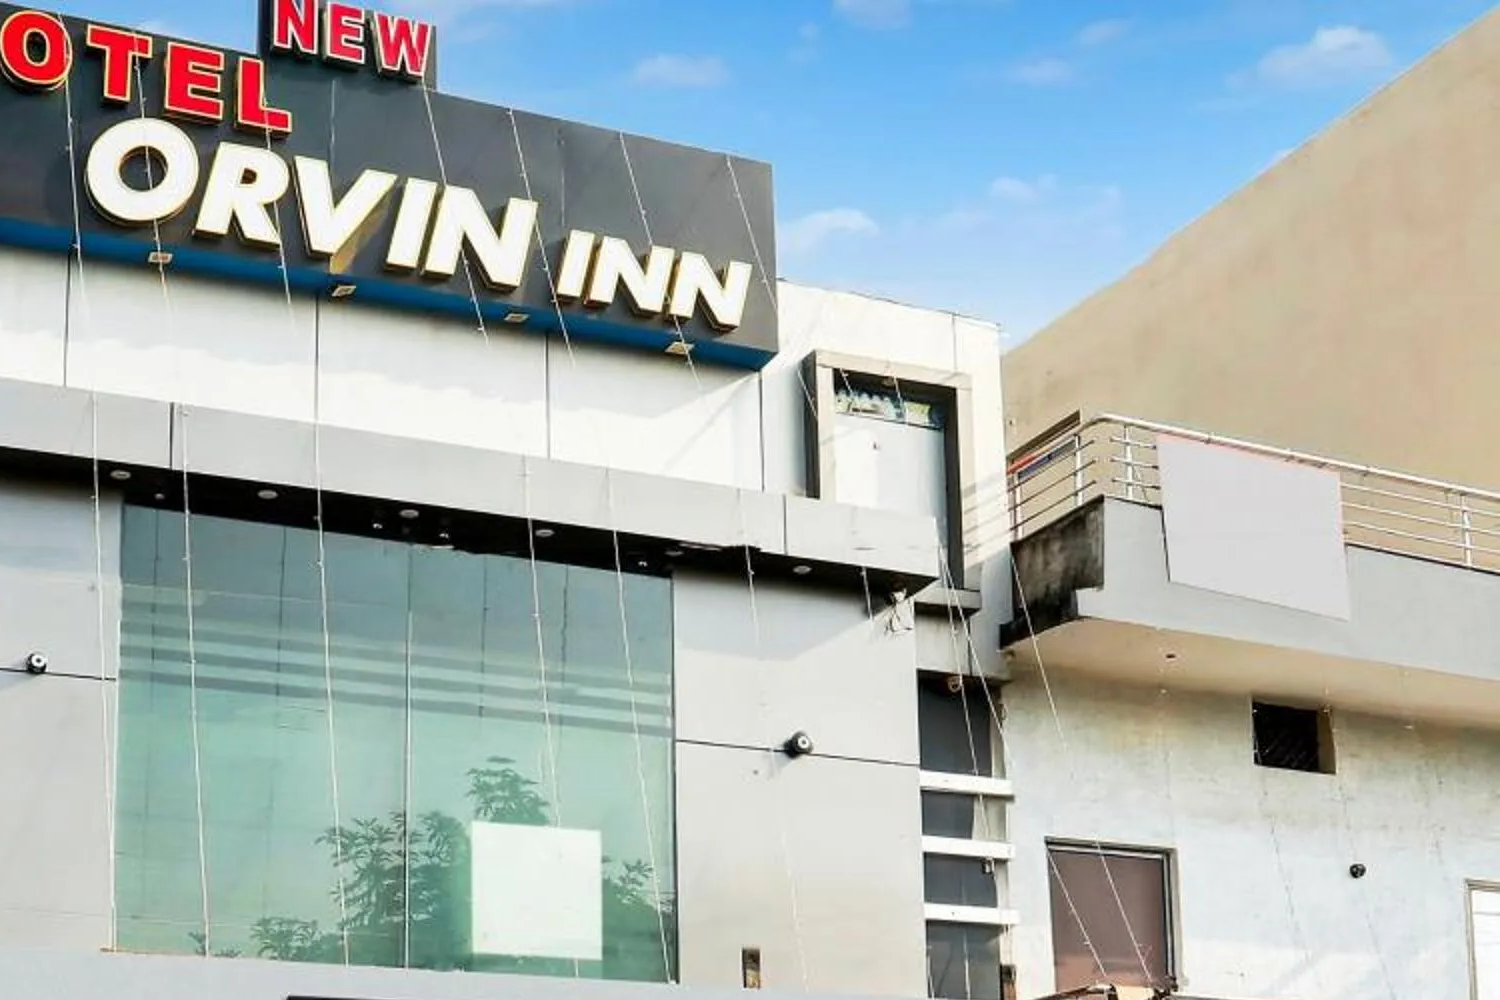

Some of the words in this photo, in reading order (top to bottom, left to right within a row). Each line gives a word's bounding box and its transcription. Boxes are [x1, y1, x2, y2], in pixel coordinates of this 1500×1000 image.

[272, 0, 431, 77] NEW
[83, 117, 539, 290] ORVIN
[556, 228, 753, 330] INN
